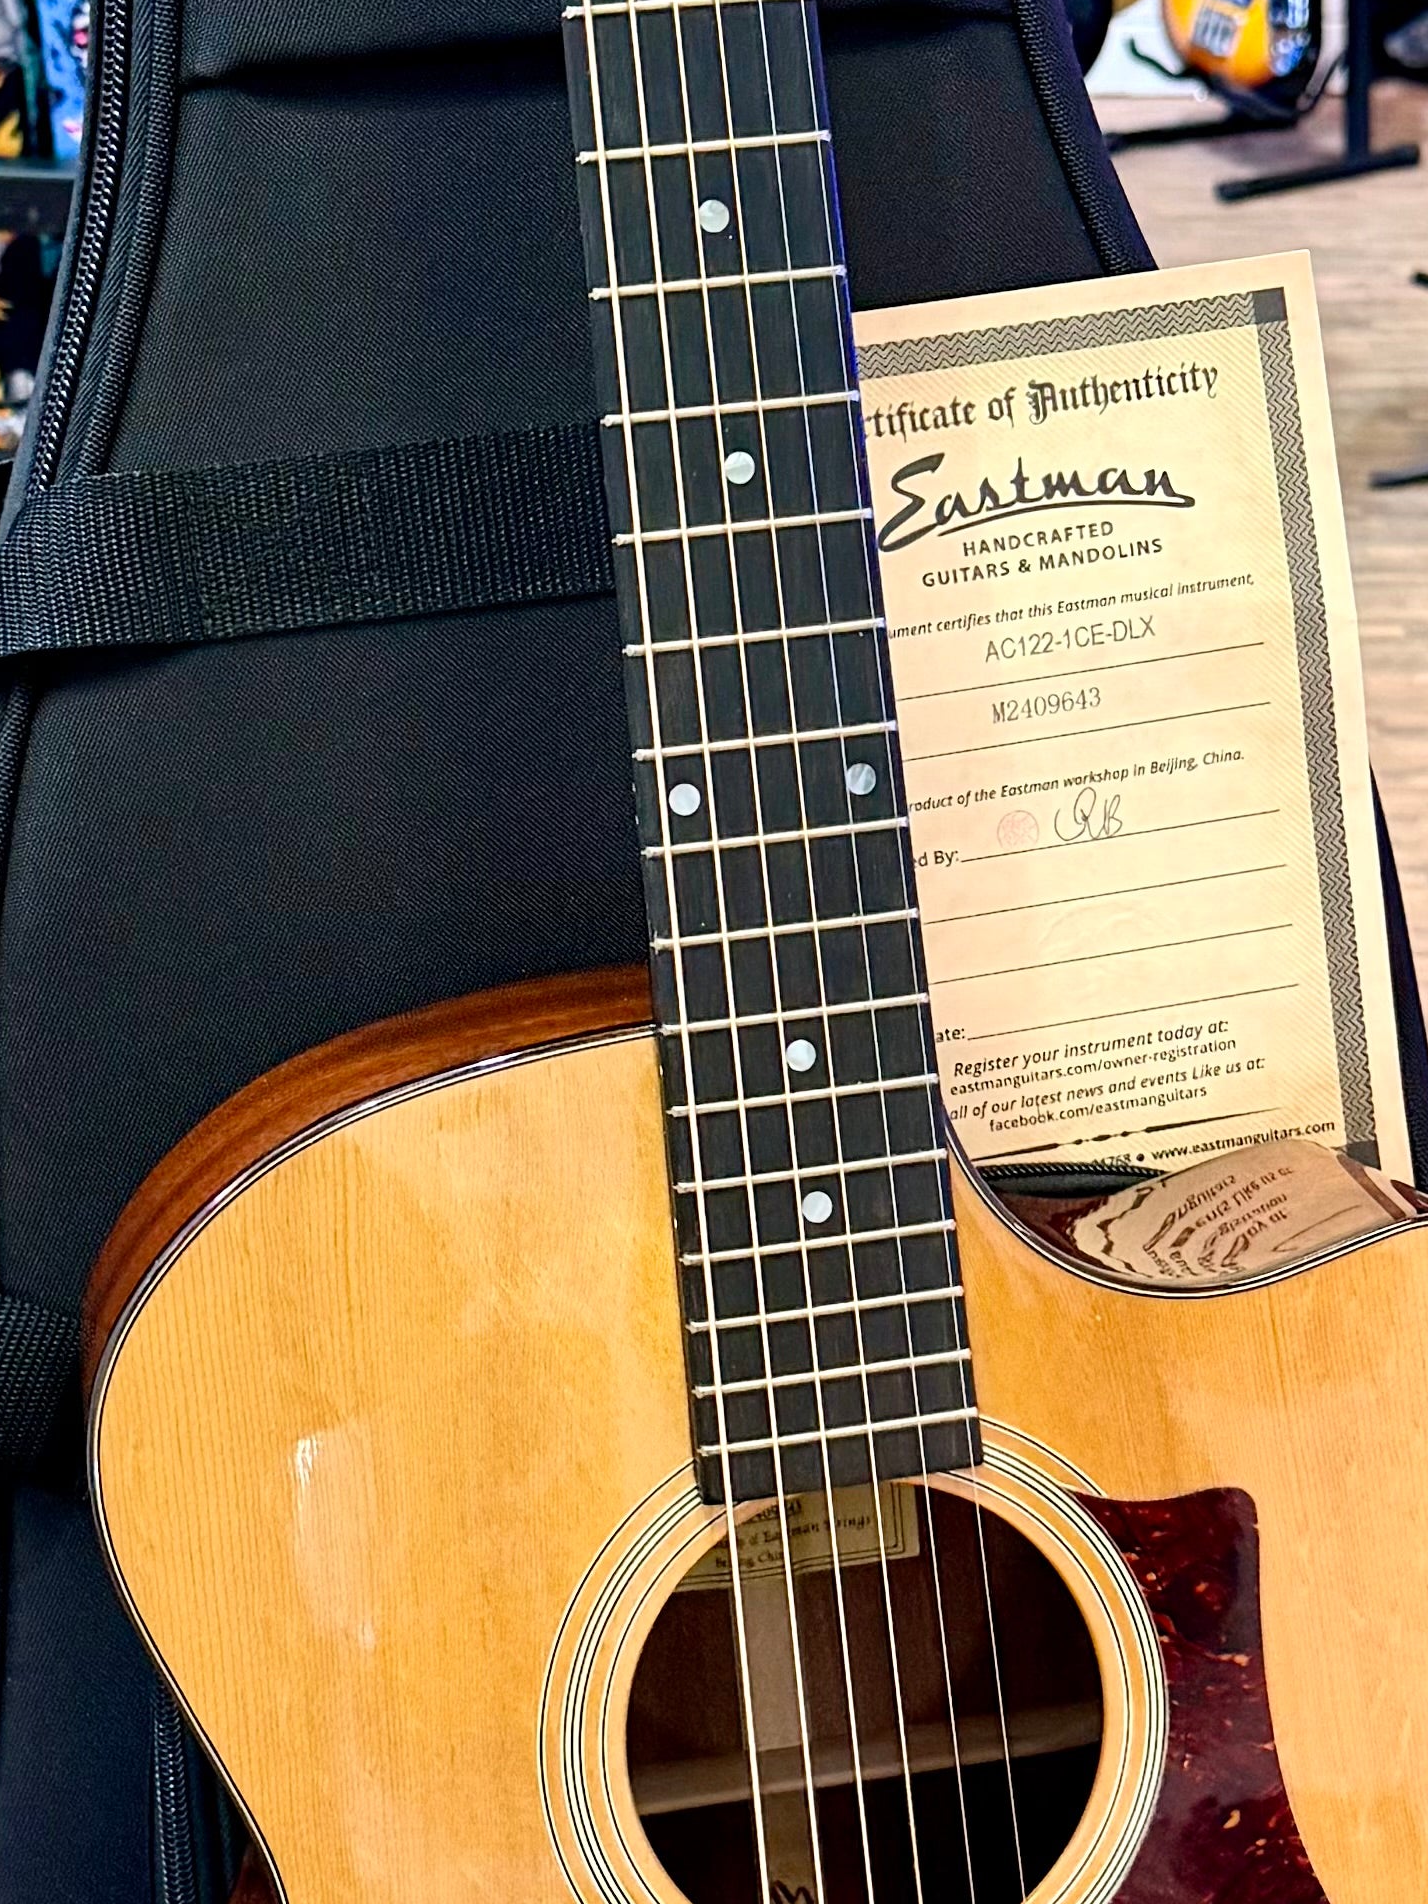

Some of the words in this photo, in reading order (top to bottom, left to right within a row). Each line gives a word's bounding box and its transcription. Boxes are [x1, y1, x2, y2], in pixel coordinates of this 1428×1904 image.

[987, 386, 1018, 427] of
[1028, 361, 1218, 425] Authenticity
[878, 452, 1196, 553] Eastman
[922, 561, 1010, 588] GUITARS
[1018, 559, 1032, 574] &
[1039, 538, 1164, 571] MANDOLINS
[962, 520, 1114, 558] HANDCRAFTED
[936, 612, 992, 632] certifies
[995, 607, 1024, 624] that
[1028, 602, 1053, 619] this
[1057, 594, 1117, 615] Eastman
[1120, 583, 1173, 605] musical
[984, 615, 1156, 663] AC122-1CE-DLX
[992, 687, 1102, 724] M2409643
[957, 789, 972, 808] of
[975, 788, 996, 803] the
[1001, 779, 1059, 798] Eastman
[1063, 767, 1130, 788] workshop
[1133, 763, 1146, 776] in
[1203, 748, 1245, 765] China.
[934, 850, 959, 868] By:
[950, 1038, 1237, 1096] eastmanguitars.com/owner-registration
[954, 1056, 1019, 1078] Register
[1022, 1047, 1060, 1070] your
[1064, 1034, 1153, 1059] instrument
[1158, 1022, 1203, 1045] today
[950, 1104, 968, 1120] all
[972, 1100, 988, 1119] of
[992, 1099, 1018, 1114] our
[1021, 1091, 1063, 1110] latest
[1067, 1084, 1105, 1102] news
[1108, 1077, 1136, 1094] and
[1140, 1071, 1187, 1089] events
[1192, 1063, 1222, 1081] Like
[1225, 1061, 1242, 1075] us
[989, 1084, 1208, 1133] facebook.com/eastmanguitars
[1151, 1121, 1336, 1160] www.eastmanguitars.com
